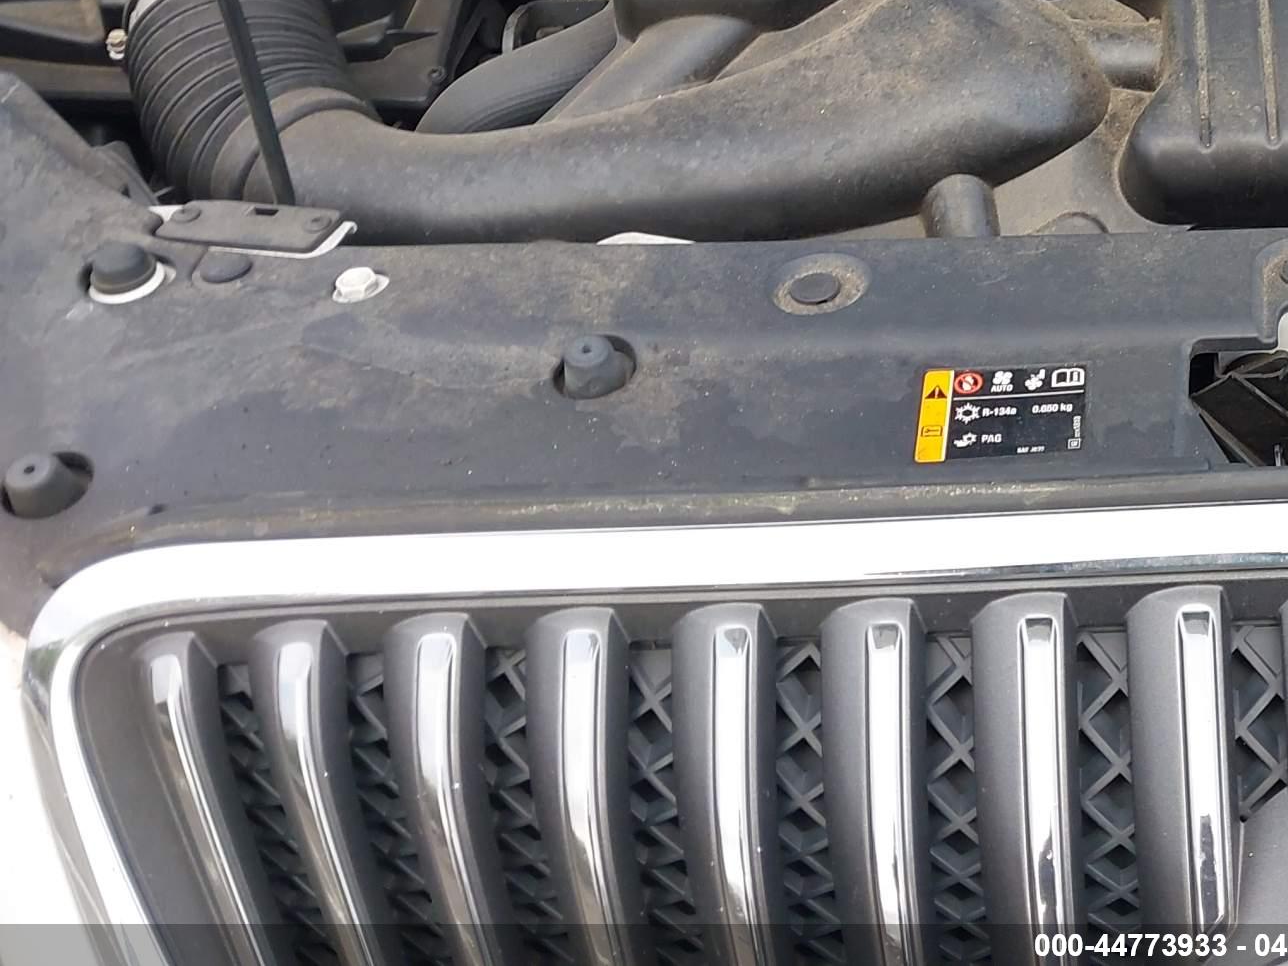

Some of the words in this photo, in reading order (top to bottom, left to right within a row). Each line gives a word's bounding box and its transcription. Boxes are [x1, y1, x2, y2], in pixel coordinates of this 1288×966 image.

[982, 407, 1017, 417] R-134a
[1060, 402, 1073, 413] kg
[982, 434, 1001, 443] PAG
